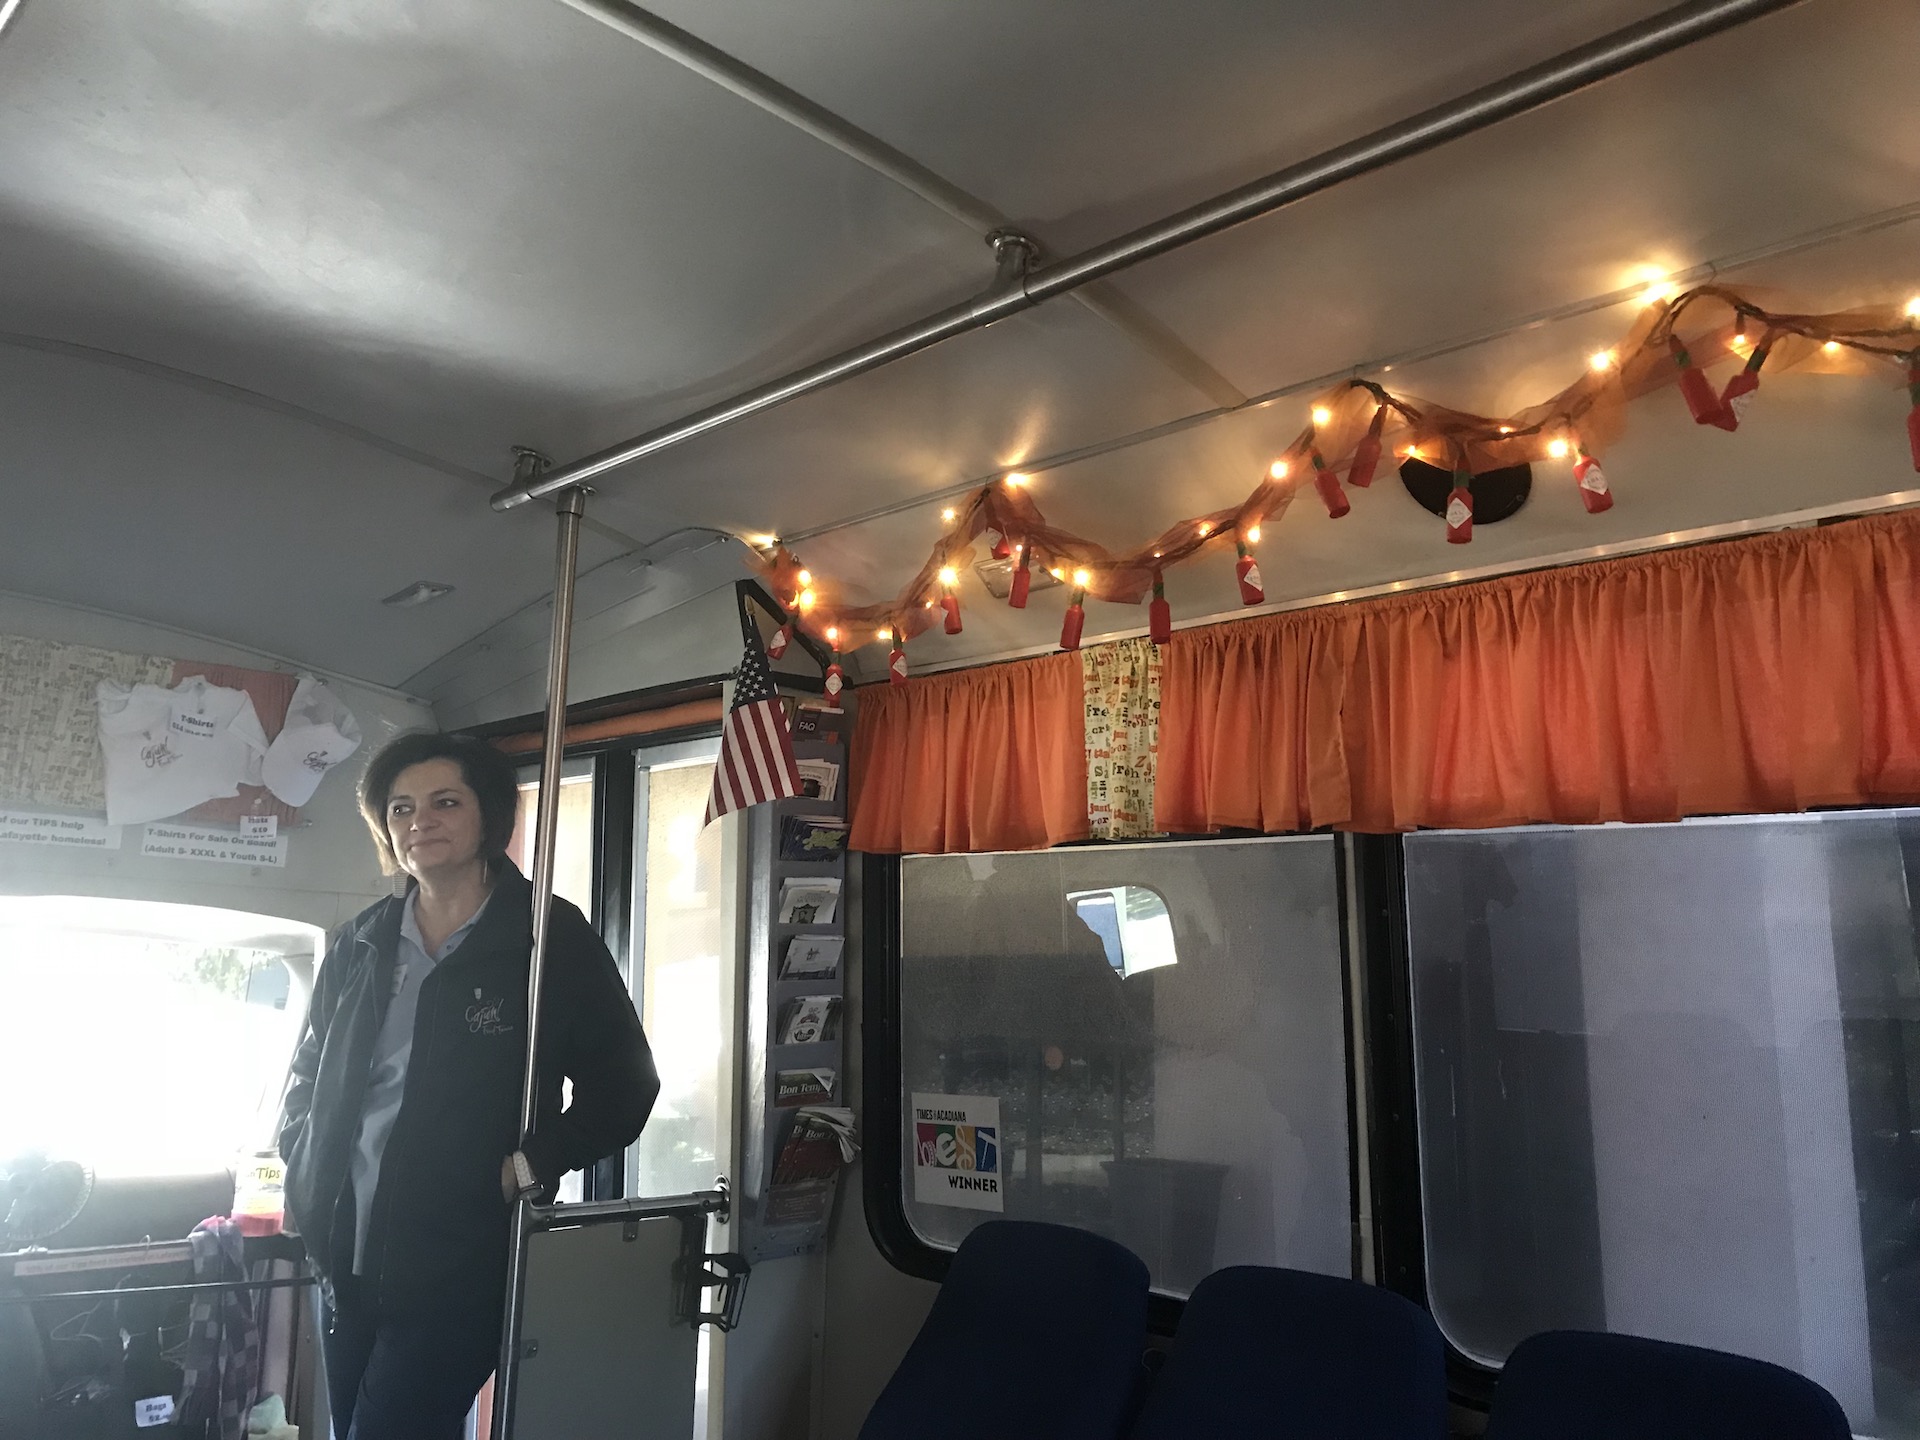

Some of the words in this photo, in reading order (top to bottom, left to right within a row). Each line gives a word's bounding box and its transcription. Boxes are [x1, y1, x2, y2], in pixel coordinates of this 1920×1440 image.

[181, 714, 214, 728] T-Shirts
[798, 721, 816, 732] FAQ
[10, 817, 29, 825] our
[32, 818, 57, 827] TIPS
[61, 820, 85, 831] help
[0, 830, 48, 841] afayette
[51, 834, 106, 845] homeless!
[147, 828, 186, 839] T-Shirts
[189, 832, 205, 841] For
[208, 834, 229, 843] Sale
[247, 838, 277, 848] Board!
[190, 848, 216, 857] XXXL
[230, 852, 257, 861] Youth
[779, 1085, 798, 1095] Bon
[916, 1108, 933, 1120] TIMES
[936, 1109, 967, 1122] ACADIANA
[805, 1128, 825, 1139] Bon
[255, 1167, 281, 1179] Tips
[948, 1175, 998, 1193] WINNER
